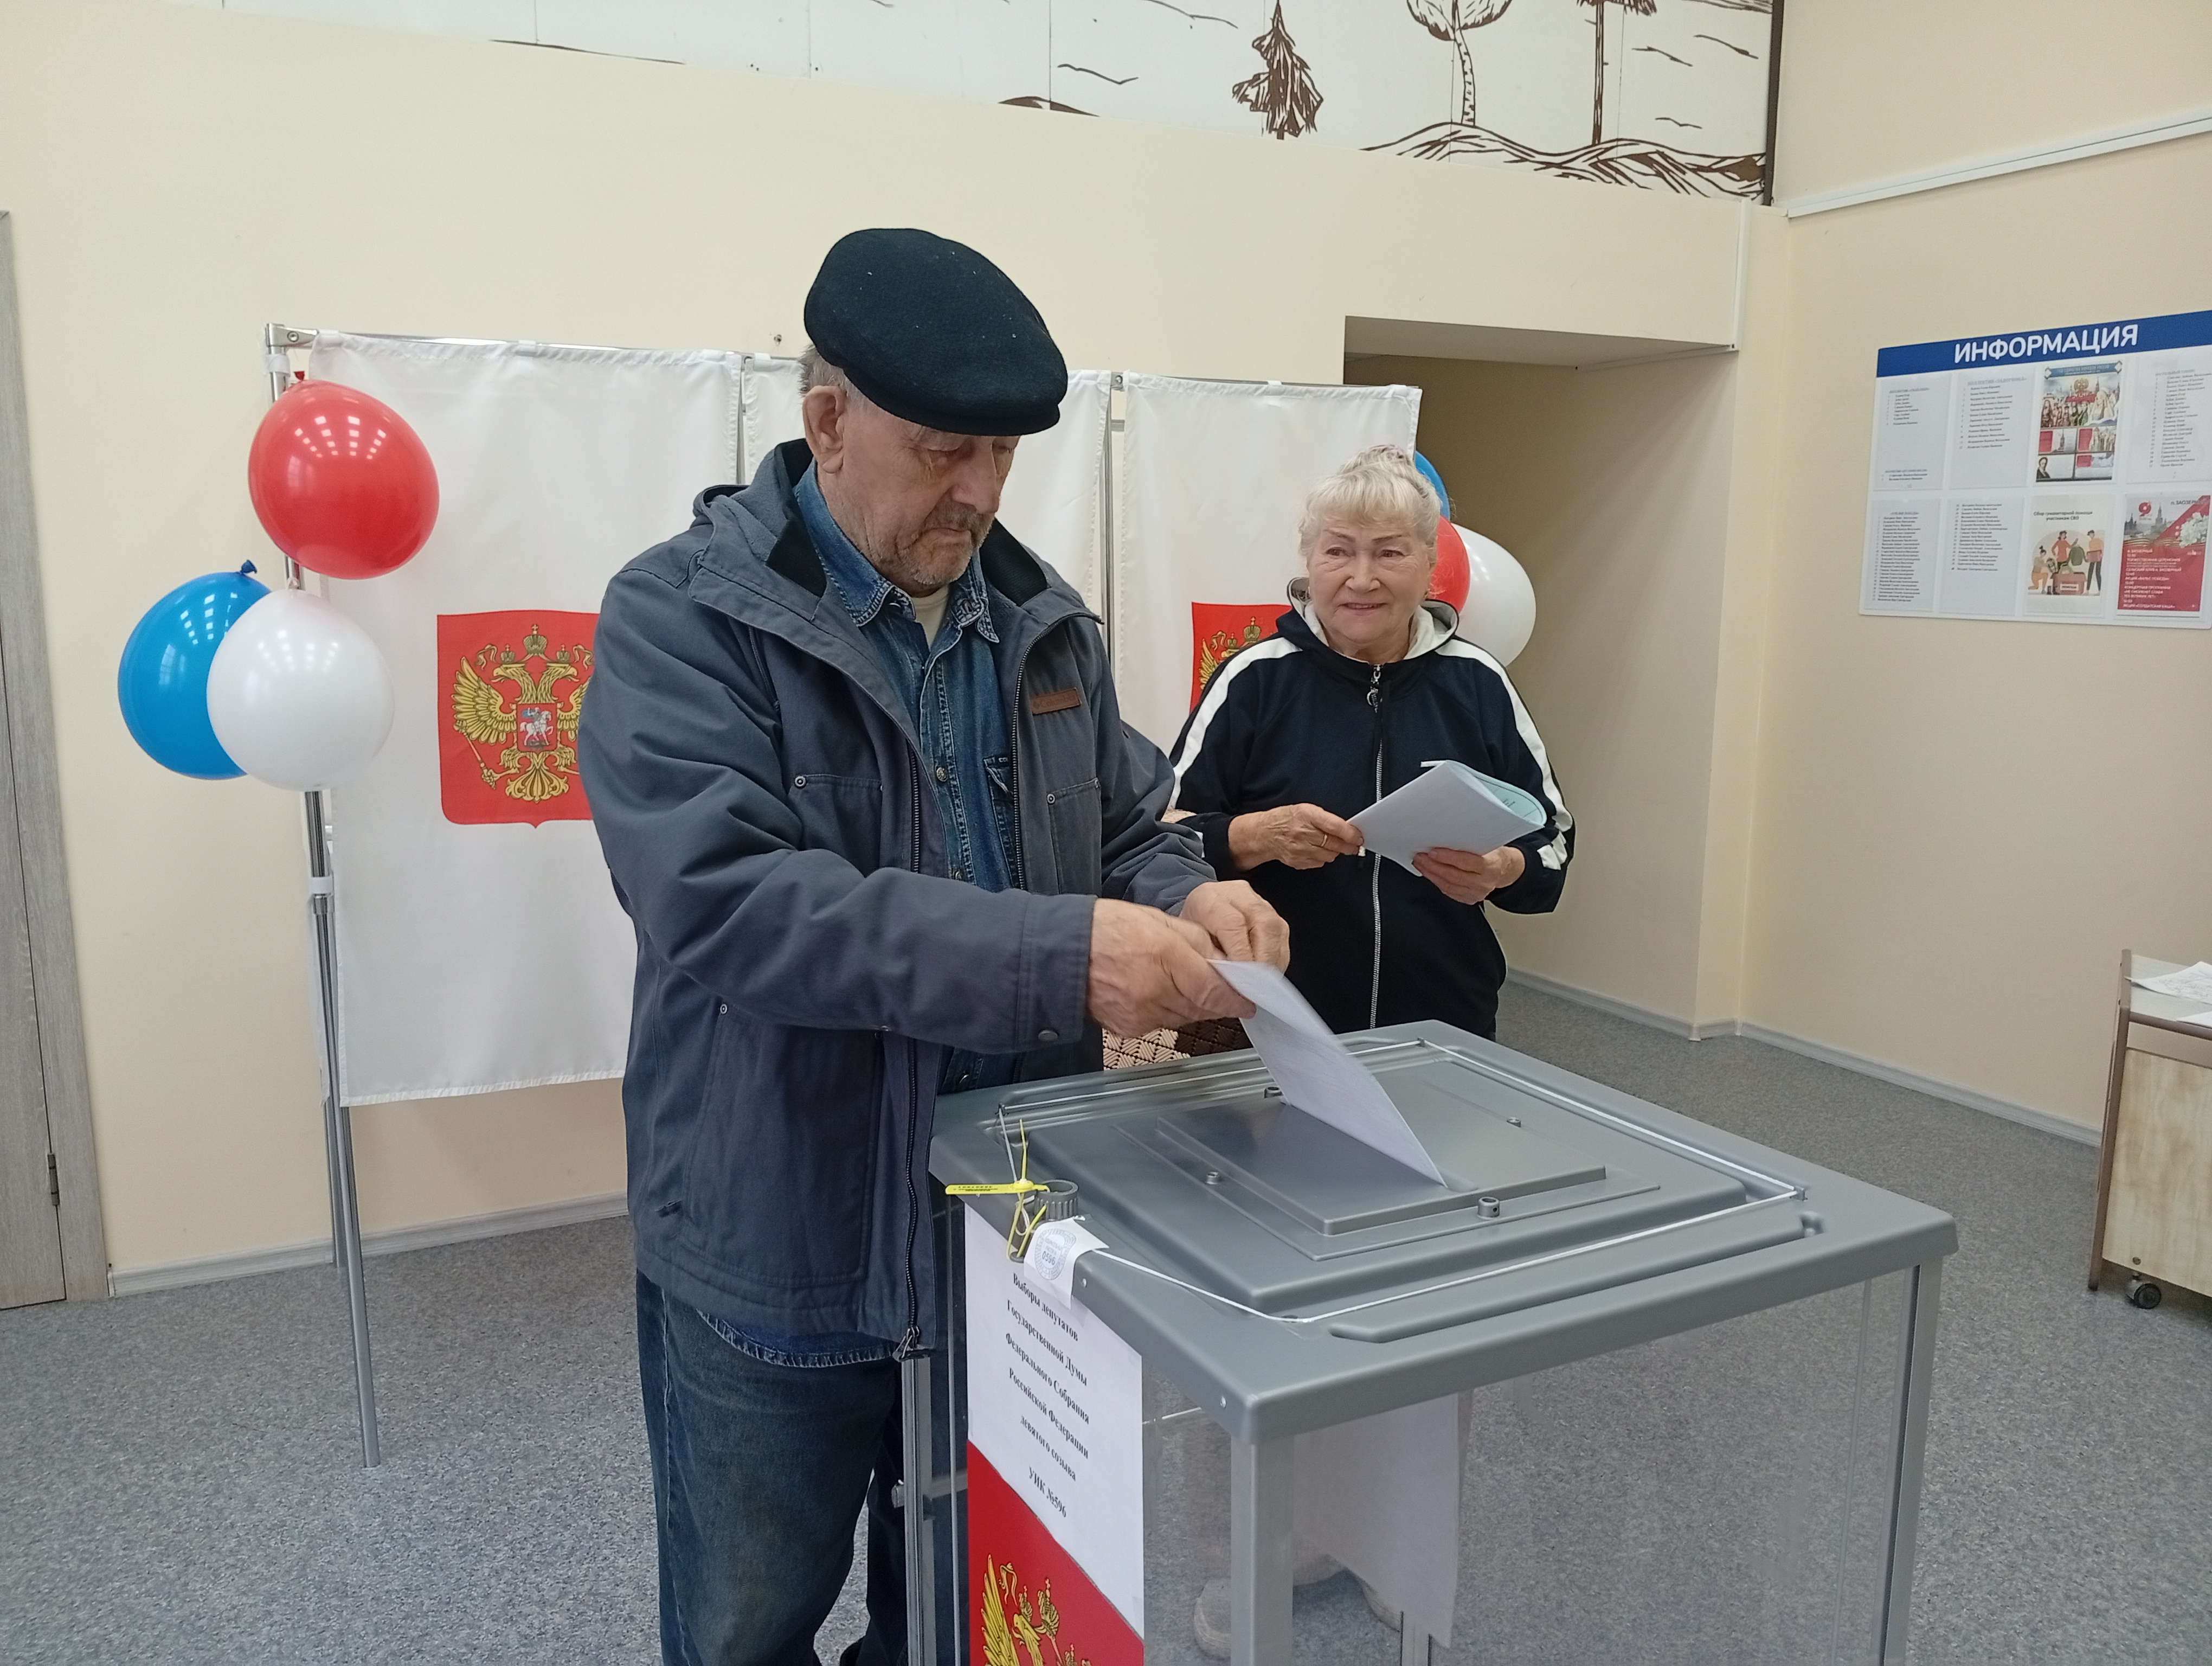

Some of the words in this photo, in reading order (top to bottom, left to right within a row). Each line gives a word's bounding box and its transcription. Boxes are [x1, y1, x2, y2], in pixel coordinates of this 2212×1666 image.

[1954, 324, 2138, 363] ИНФОРМАЦИЯ
[1040, 694, 1076, 708] Columbia
[1042, 1251, 1056, 1265] 0596
[1013, 1272, 1040, 1307] Выборы
[1041, 1302, 1078, 1341] депутатов
[1007, 1299, 1064, 1363] Государственной
[1065, 1356, 1087, 1386] Думы
[1006, 1332, 1052, 1387] Федерального
[1054, 1380, 1089, 1425] Собрания
[1009, 1367, 1047, 1415] Российской
[1049, 1410, 1088, 1459] Федерации
[1020, 1415, 1050, 1452] девятого
[1051, 1449, 1076, 1481] созыва
[1029, 1465, 1045, 1494] УИК
[1046, 1487, 1066, 1518] №596
